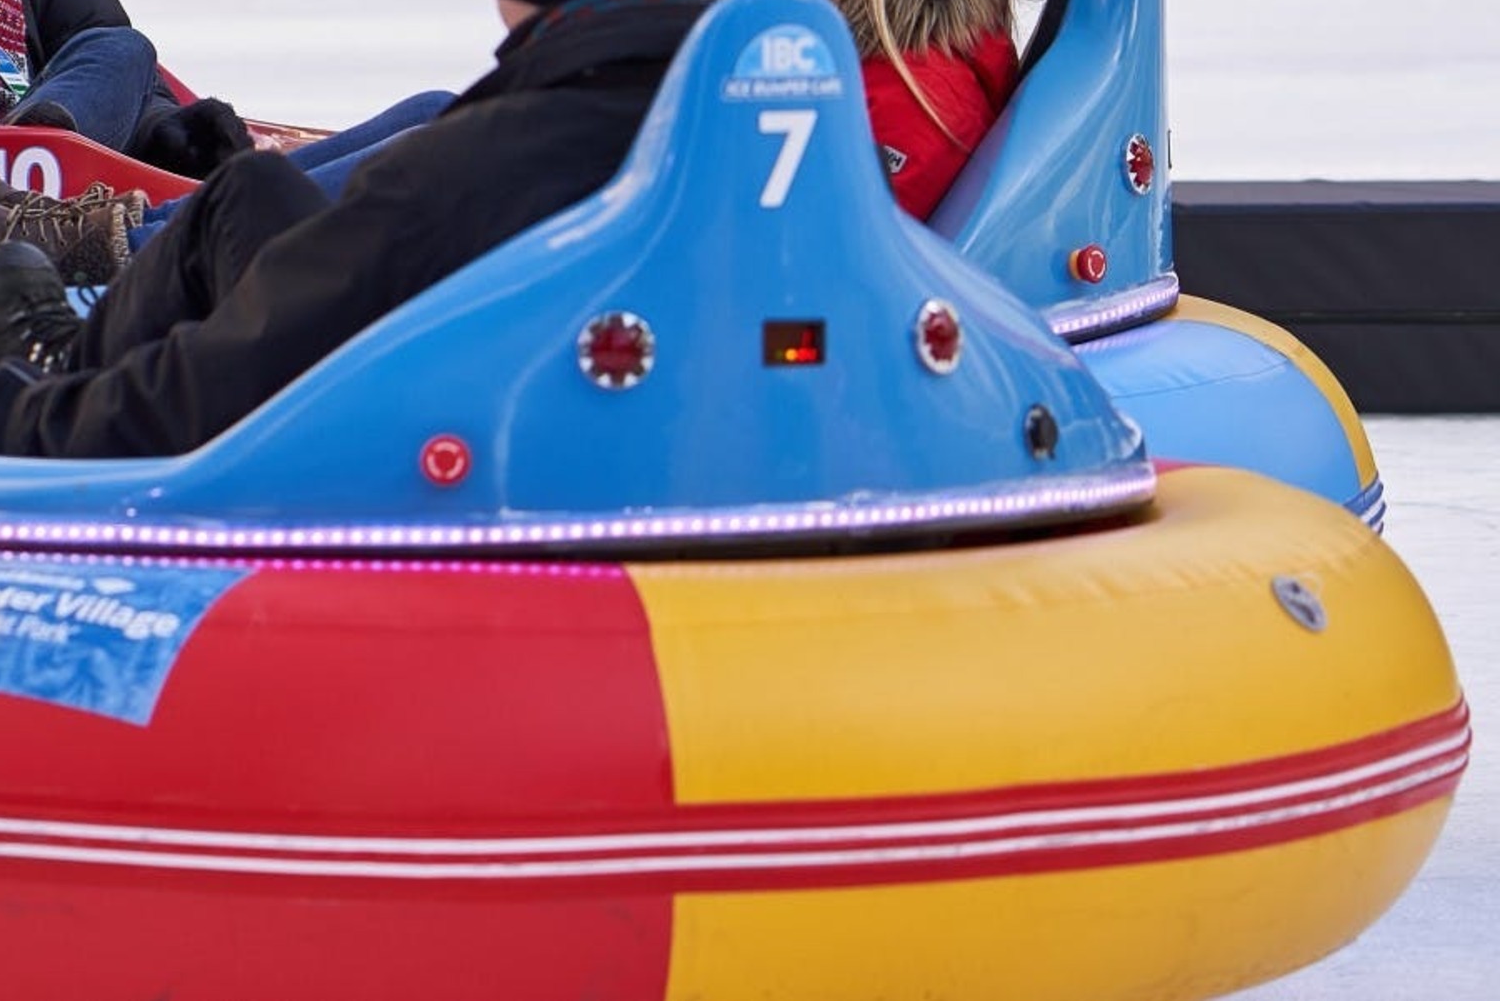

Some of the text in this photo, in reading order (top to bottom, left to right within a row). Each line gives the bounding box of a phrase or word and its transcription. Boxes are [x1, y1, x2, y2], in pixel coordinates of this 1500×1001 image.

[761, 35, 816, 73] IBC
[759, 109, 818, 208] 7
[55, 591, 181, 640] Village
